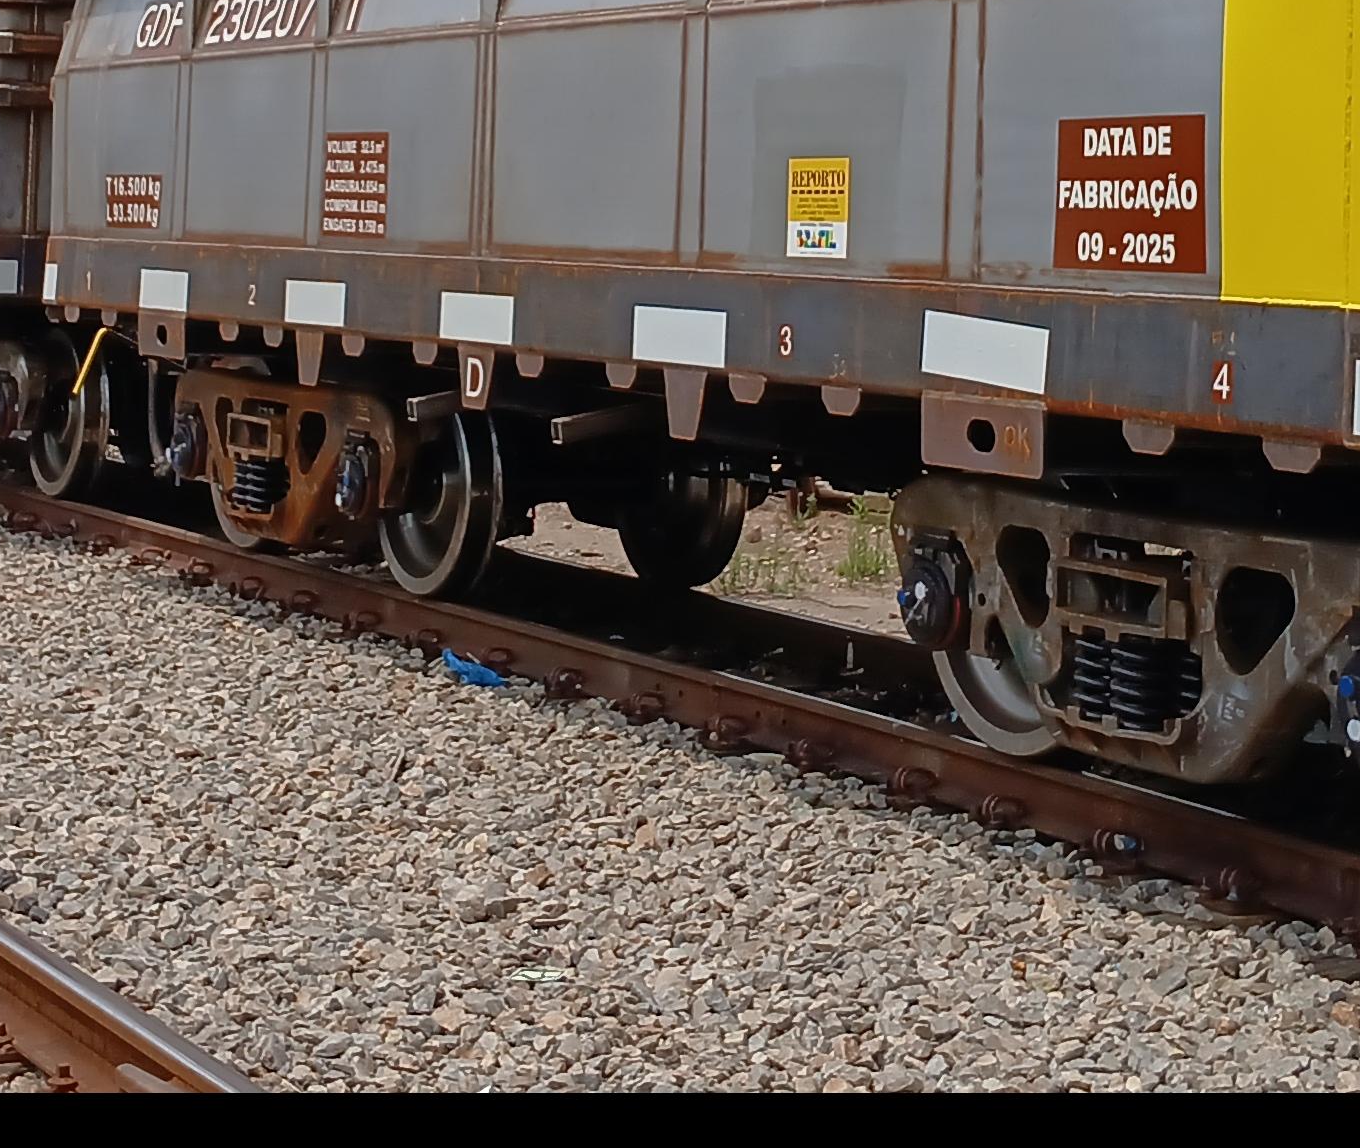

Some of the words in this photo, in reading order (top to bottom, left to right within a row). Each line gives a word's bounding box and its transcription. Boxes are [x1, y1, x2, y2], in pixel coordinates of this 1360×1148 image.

[1083, 126, 1137, 157] DATA
[1142, 125, 1172, 156] DE
[791, 169, 846, 188] REPORTO
[1058, 172, 1198, 218] FABRICAÇÃO
[1077, 231, 1104, 262] 09
[1121, 232, 1176, 264] 2025
[247, 284, 257, 306] 2
[779, 325, 792, 356] 3
[466, 356, 484, 398] D
[1213, 363, 1231, 400] 4
